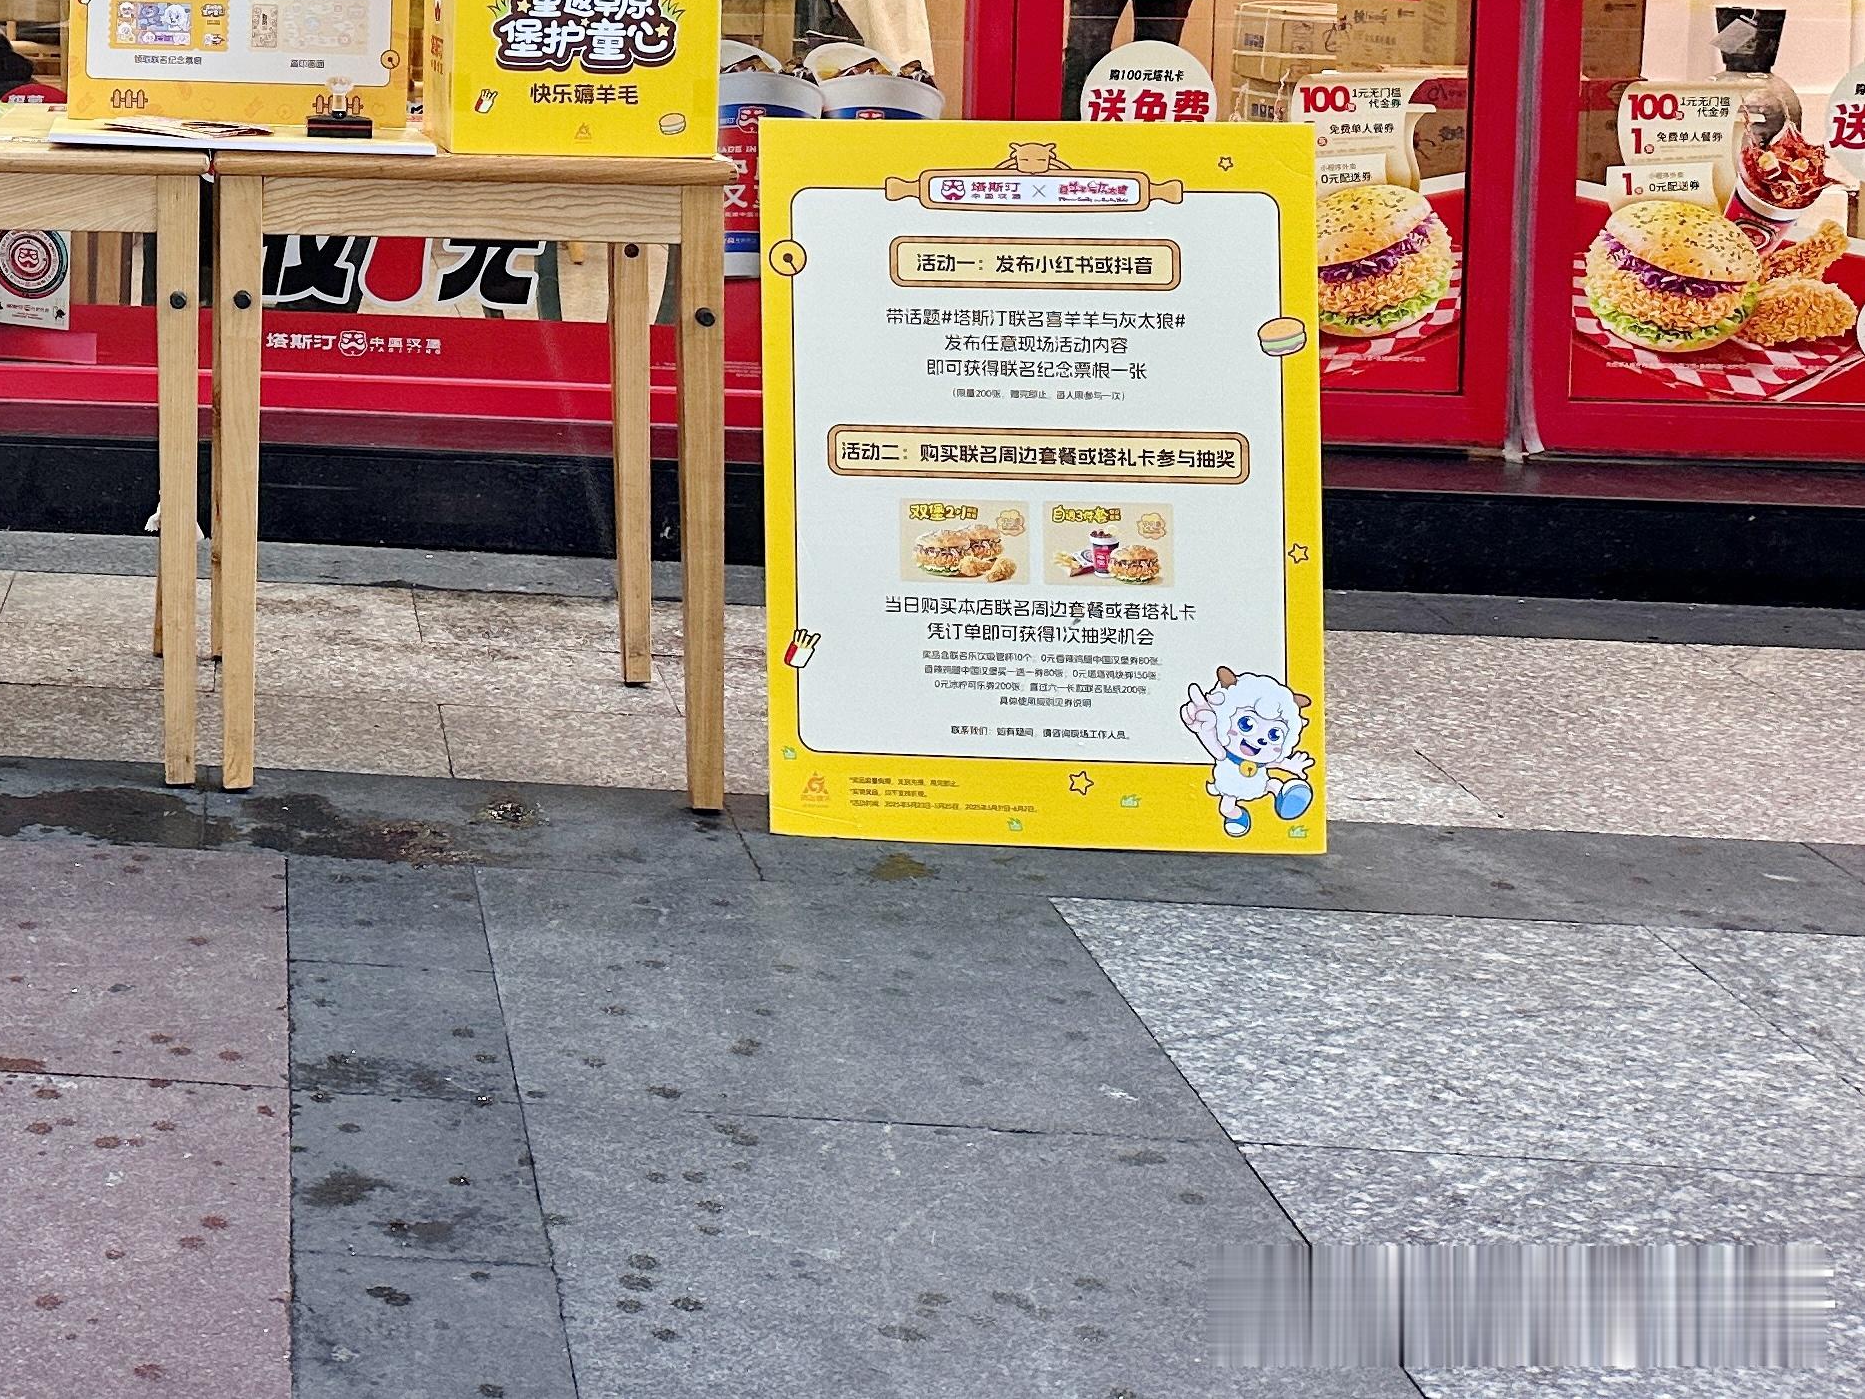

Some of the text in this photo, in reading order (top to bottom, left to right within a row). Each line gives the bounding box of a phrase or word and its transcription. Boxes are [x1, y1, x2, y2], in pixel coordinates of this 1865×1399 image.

[499, 20, 669, 61] 堡护童心
[1109, 68, 1185, 82] 购100元塔礼卡
[529, 83, 639, 106] 快乐薅羊毛
[1088, 88, 1209, 121] 送免费
[1300, 85, 1350, 113] 100
[1368, 99, 1402, 109] 代金券
[1627, 93, 1678, 121] 100
[1697, 107, 1730, 118] 代金券
[1329, 123, 1395, 135] 免费单人餐券
[1656, 131, 1724, 143] 免费单人餐券
[970, 181, 1021, 193] 塔斯汀
[1321, 171, 1372, 184] 0元配送券
[1648, 180, 1700, 192] 0元配送券
[916, 253, 1153, 275] 活动一：发布小红书或抖音
[886, 307, 1186, 330] 带话题#塔斯汀联名喜羊羊与灰太狼#
[265, 332, 337, 351] 塔斯汀
[944, 334, 1129, 354] 发布任意现场活动内容
[926, 359, 1148, 380] 即可获得联名纪念票根一张
[841, 442, 1236, 470] 活动二：购买联名周边套餐或塔礼卡参与抽奖
[884, 595, 1197, 621] 当日购买本店联名周边套餐或者塔礼卡
[926, 621, 1155, 646] 凭订单即可获得1次抽奖机会
